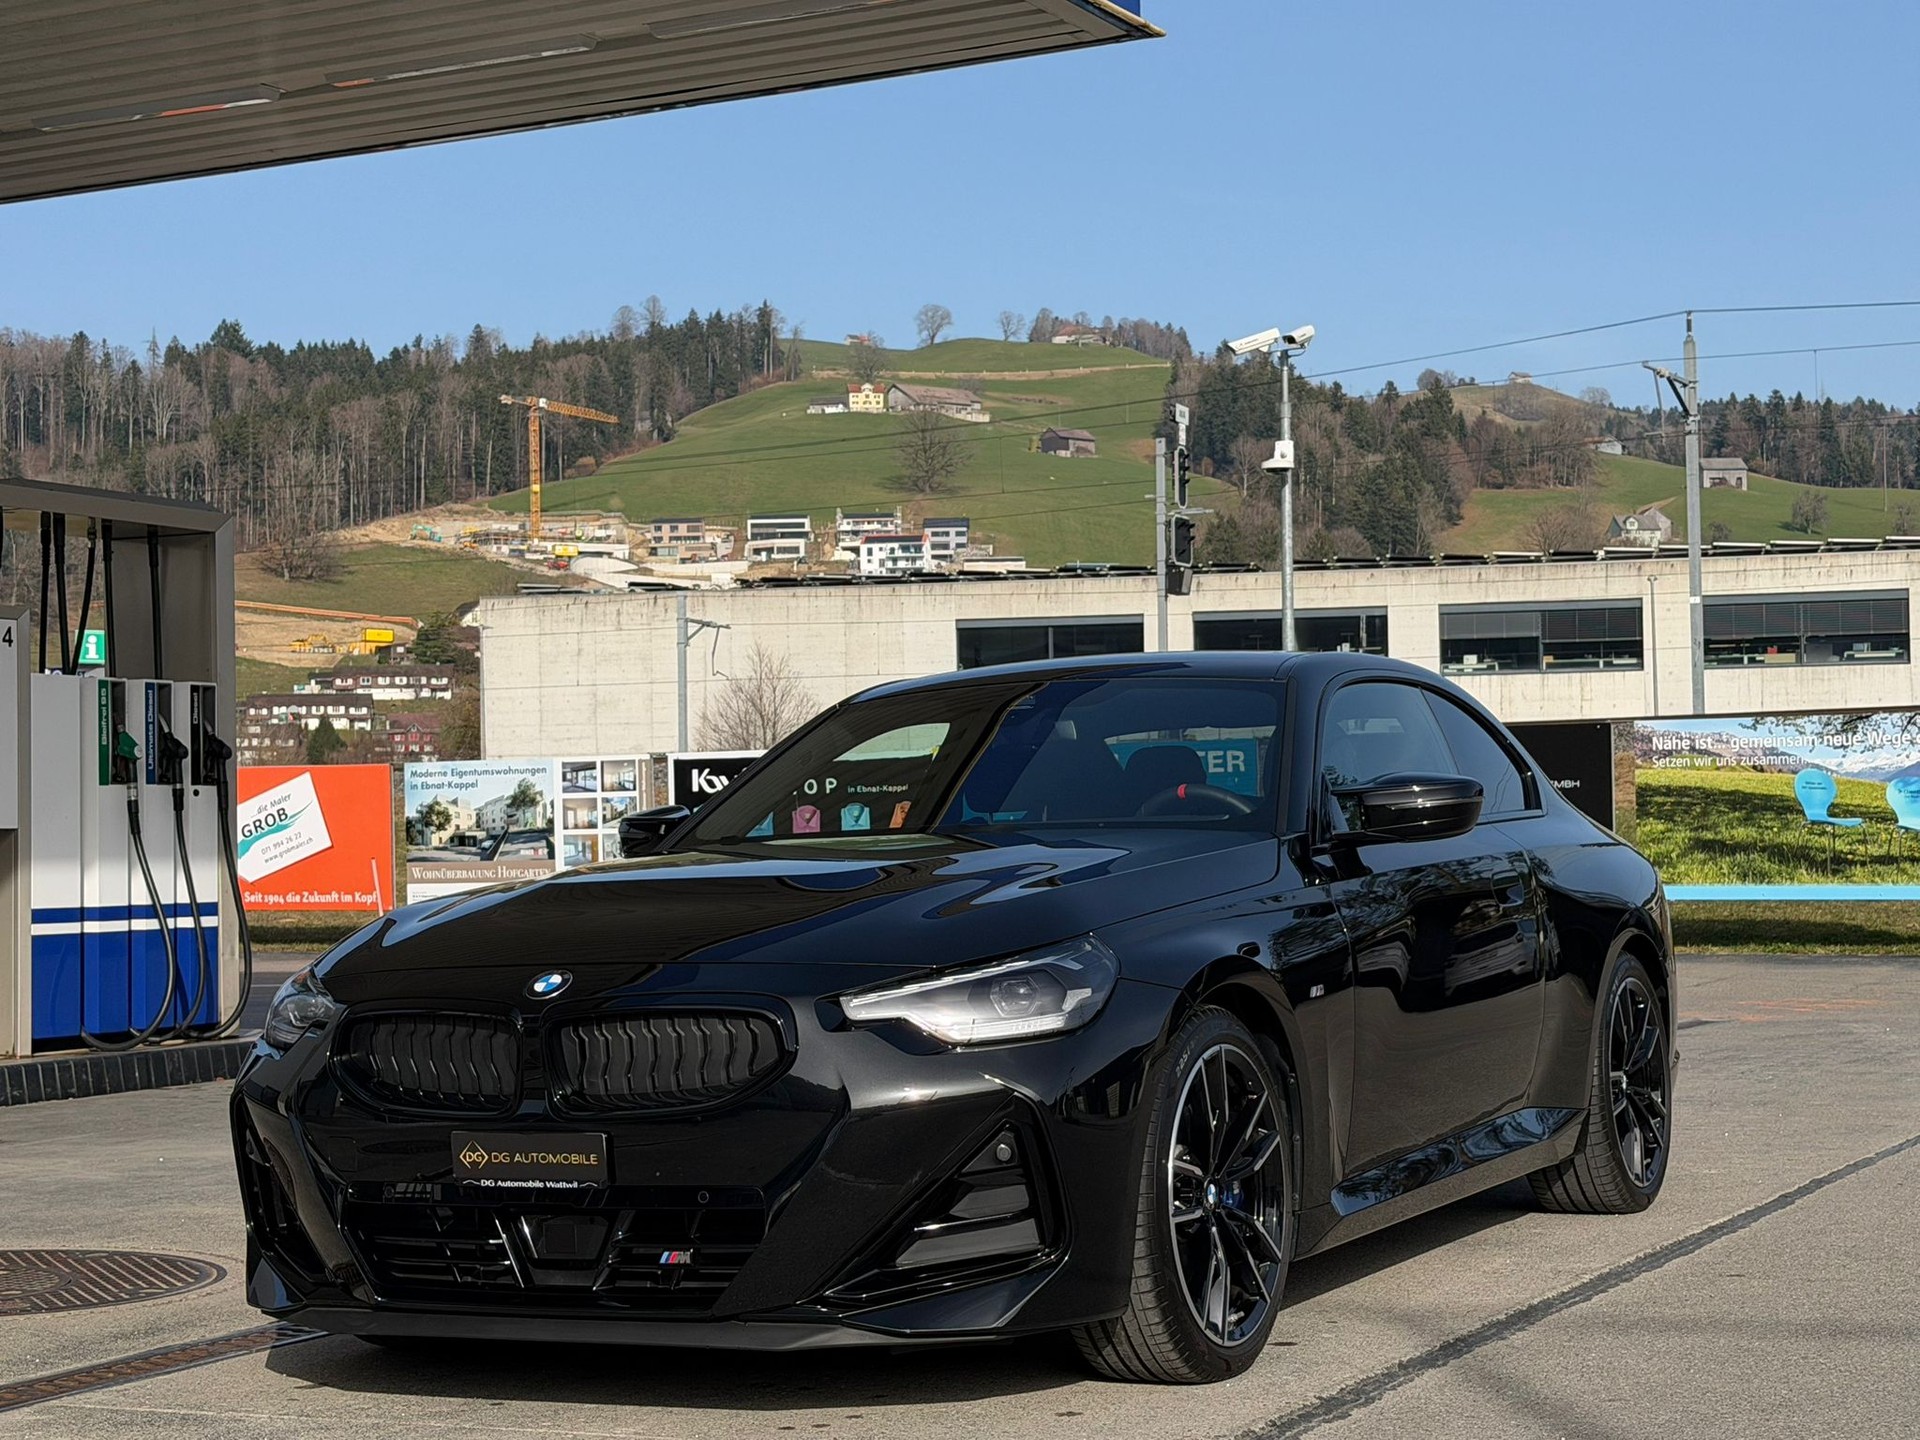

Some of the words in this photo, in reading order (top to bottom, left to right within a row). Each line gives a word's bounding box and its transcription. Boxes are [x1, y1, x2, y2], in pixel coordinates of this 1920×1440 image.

[2, 626, 13, 647] 4
[1651, 735, 1690, 750] Nähe
[1731, 734, 1817, 752] gemeinsam
[1823, 734, 1861, 746] neue
[1868, 731, 1912, 748] Wege
[1651, 755, 1690, 768] Setzen
[1694, 754, 1711, 767] wir
[1716, 755, 1737, 767] uns
[410, 769, 448, 779] Moderne
[451, 766, 547, 779] Eigentumswohnungen
[410, 783, 418, 791] in
[421, 780, 479, 791] Ebnat-Kappel
[270, 793, 292, 808] Maler
[241, 807, 289, 839] GROB
[244, 892, 262, 903] Seit
[264, 896, 284, 905] 1904
[286, 892, 300, 903] die
[302, 891, 339, 903] Zukunft
[341, 892, 352, 903] im
[355, 892, 377, 905] Kopf
[466, 1151, 482, 1162] DG
[491, 1152, 510, 1163] DG
[513, 1152, 598, 1165] AUTOMOBILE
[480, 1179, 495, 1187] DG
[496, 1179, 545, 1188] Automobile
[546, 1180, 578, 1188] Wattwil
